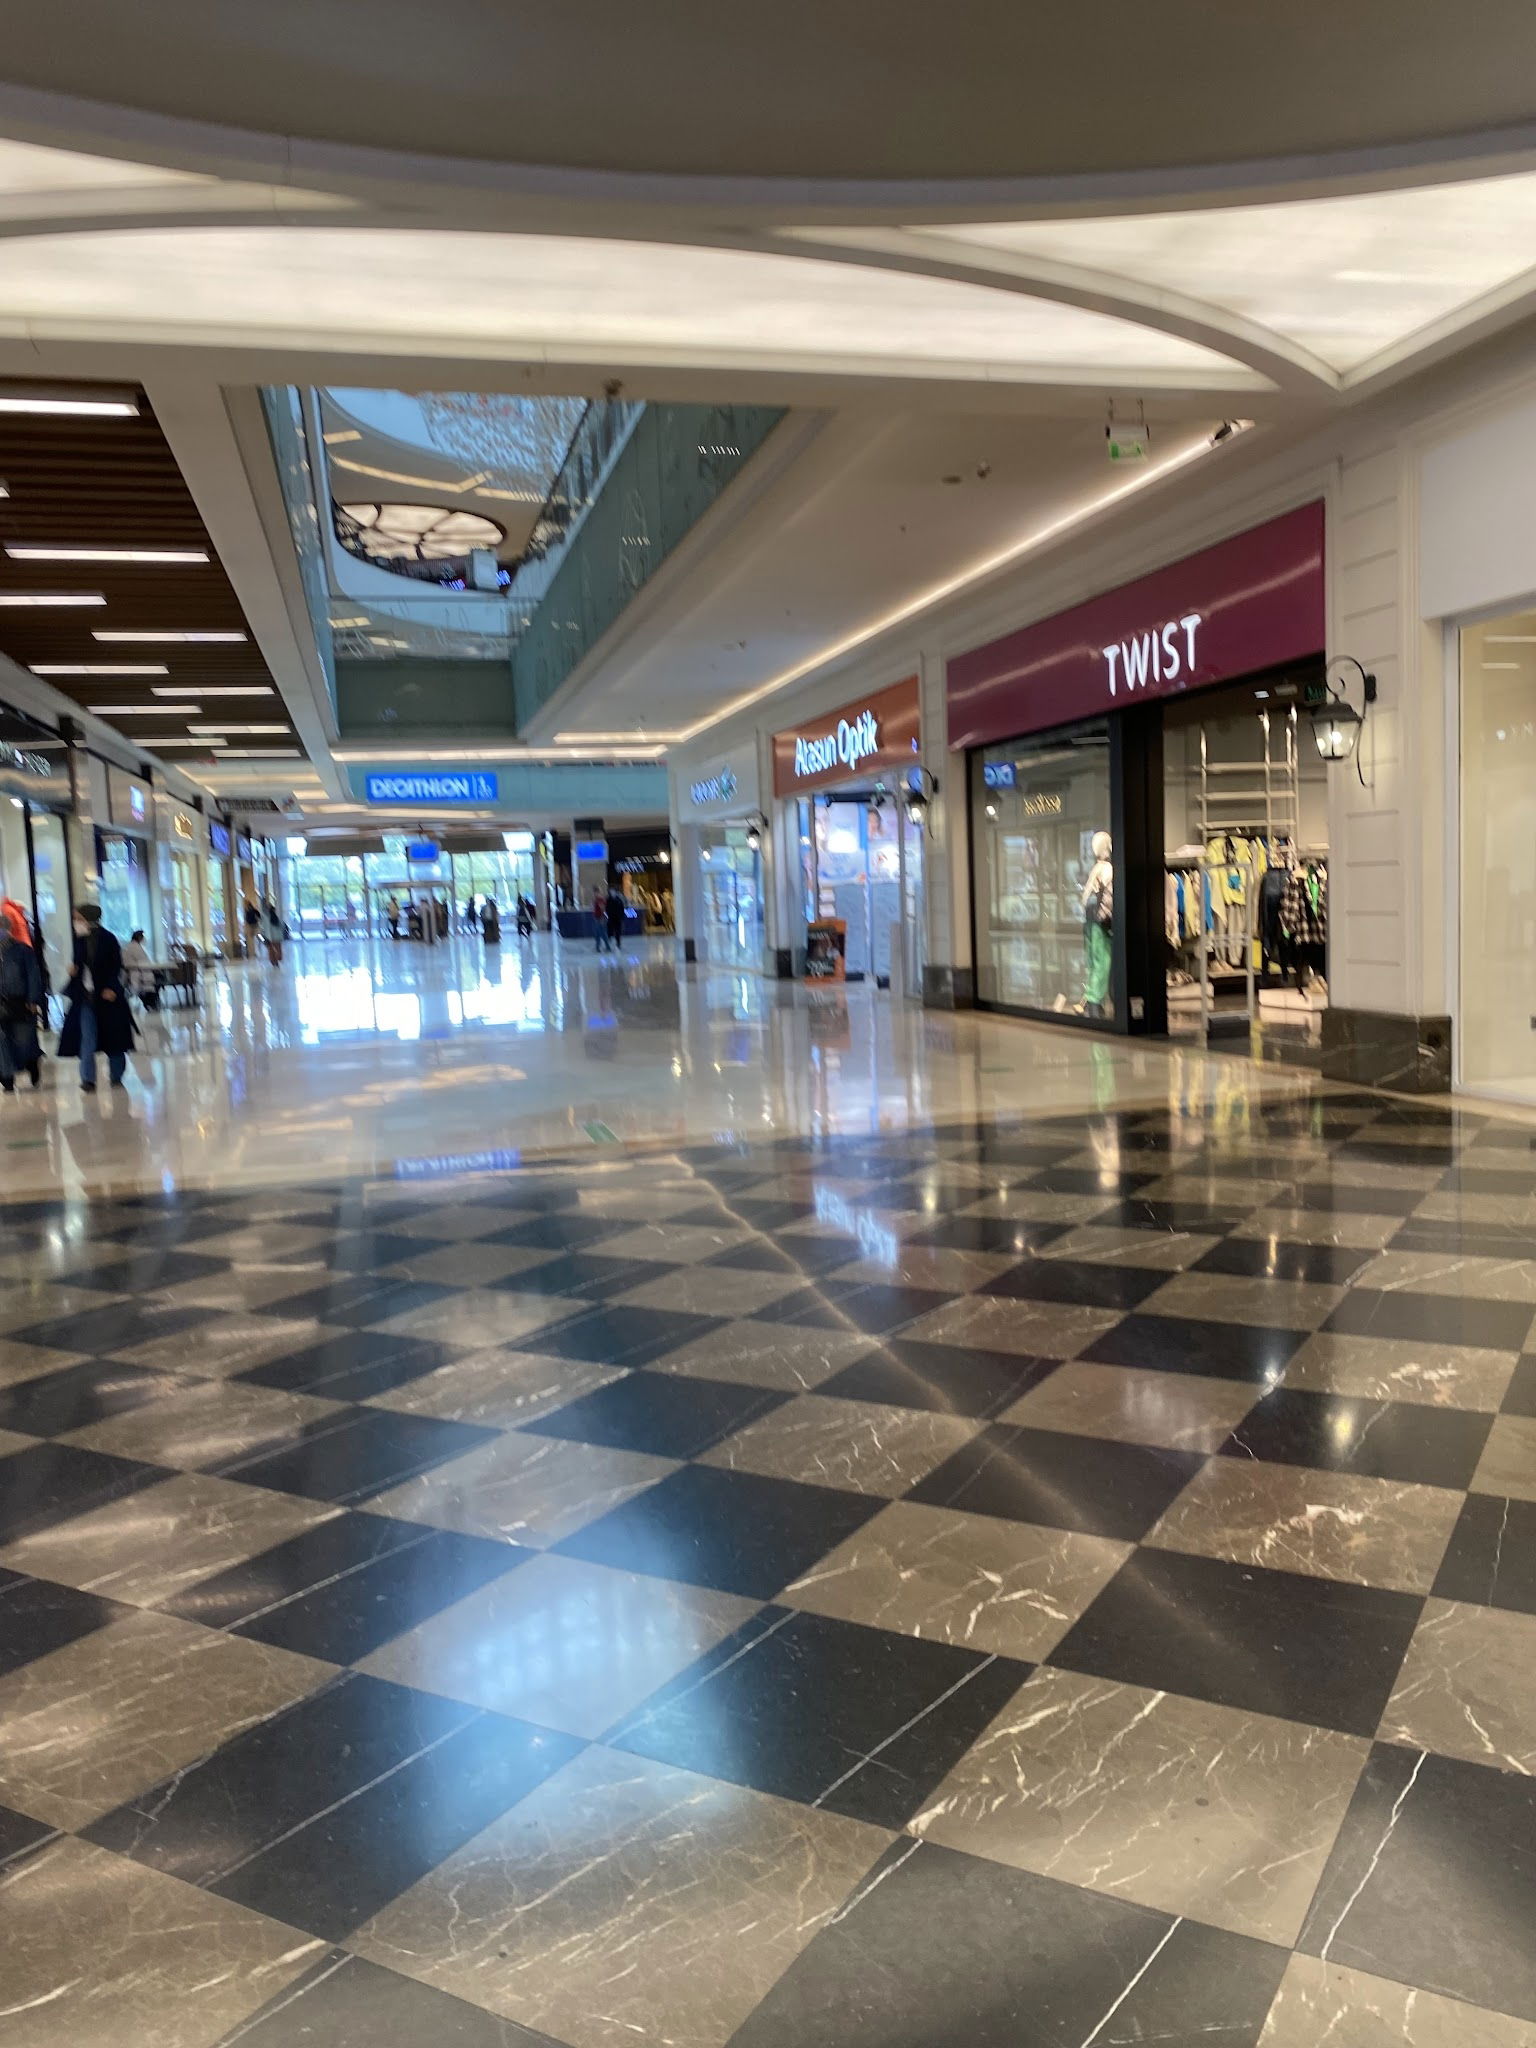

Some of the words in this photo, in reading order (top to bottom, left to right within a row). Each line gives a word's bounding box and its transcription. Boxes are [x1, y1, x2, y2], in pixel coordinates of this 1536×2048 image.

[1102, 613, 1202, 697] TWIST
[837, 709, 879, 771] Optik
[369, 777, 471, 799] DECATHLON
